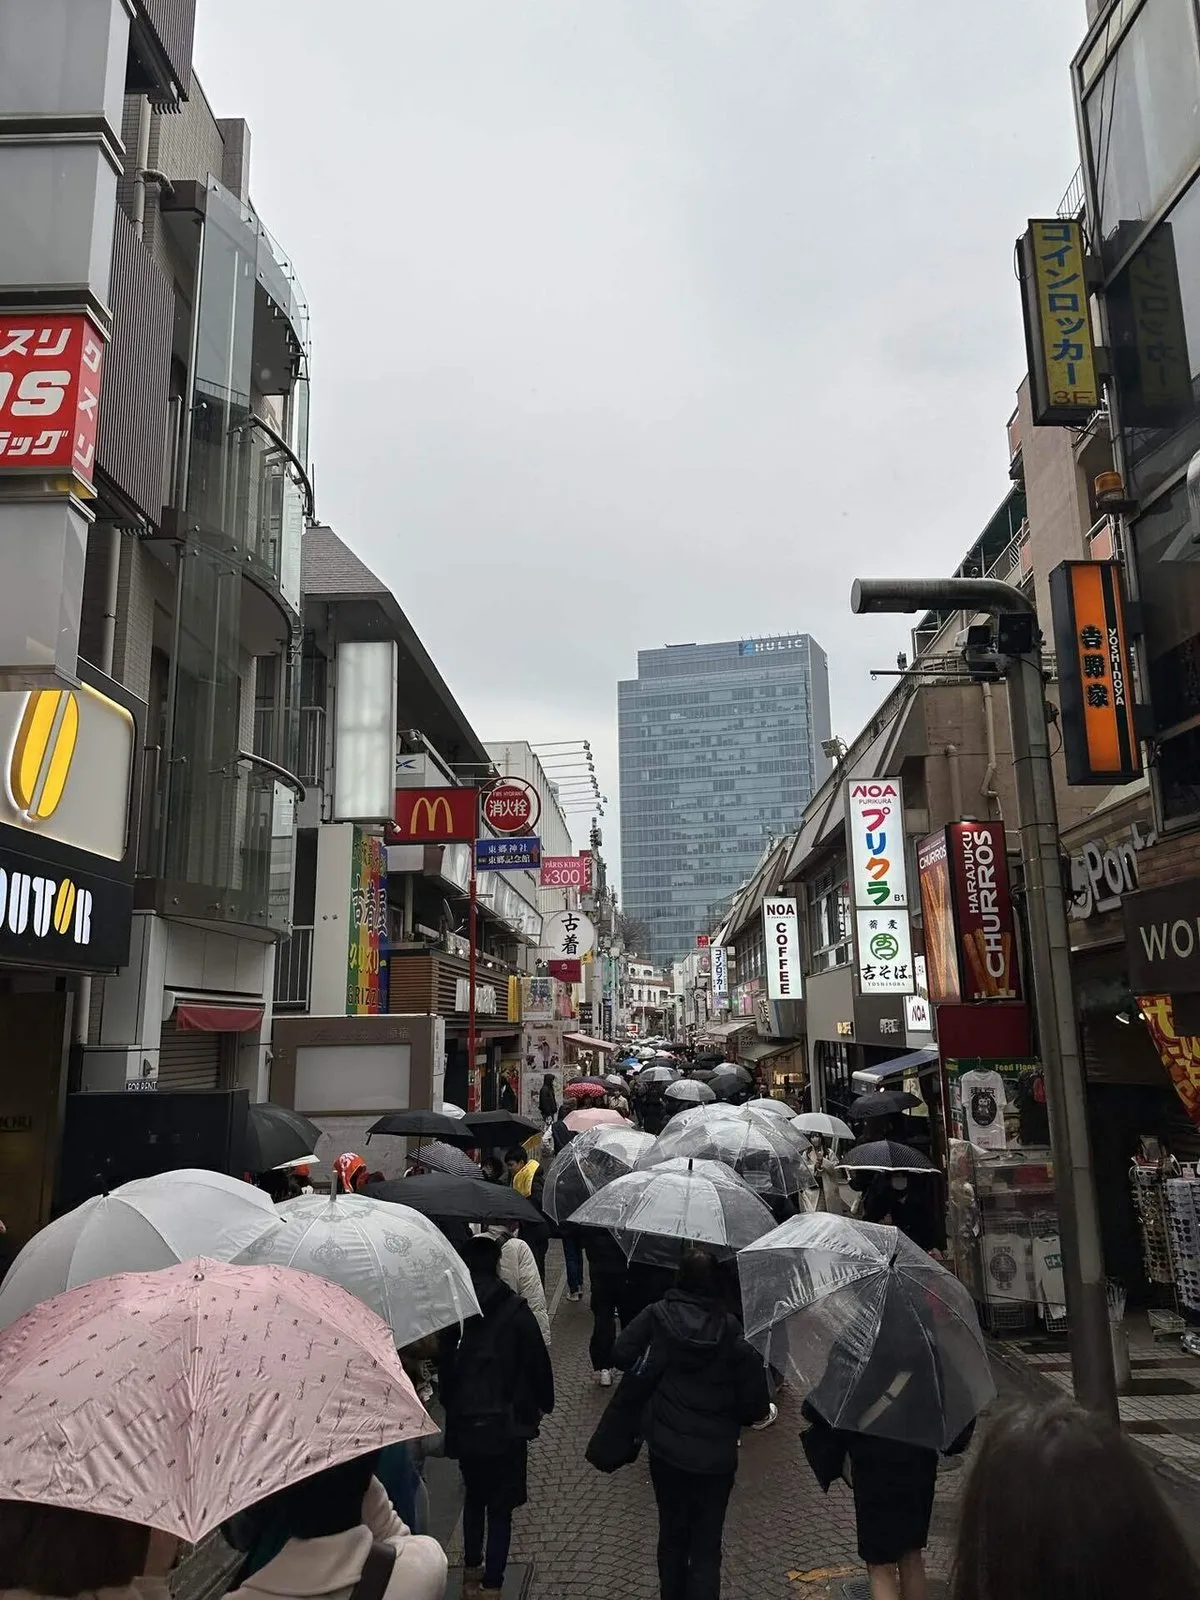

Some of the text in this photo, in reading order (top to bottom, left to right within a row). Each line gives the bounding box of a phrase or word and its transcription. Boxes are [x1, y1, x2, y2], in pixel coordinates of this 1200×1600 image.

[1040, 224, 1086, 386] コインロッカー
[0, 328, 72, 357] スリ
[0, 370, 72, 417] S
[1053, 391, 1093, 405] 3F
[755, 639, 804, 652] HULIC
[1108, 628, 1126, 706] YOSHINOYA
[852, 785, 897, 798] NOA
[490, 799, 528, 817] 消火栓
[488, 843, 528, 854] 東郷神社
[861, 807, 891, 905] プリクラ
[919, 845, 947, 870] CHURROS
[545, 869, 581, 885] ¥300
[961, 831, 980, 913] HARAJUKU
[766, 904, 796, 916] NOA
[894, 893, 905, 902] B1
[973, 830, 1005, 978] CHURROS
[561, 912, 580, 956] 古着
[776, 922, 790, 995] COFFEE
[861, 964, 908, 981] 吉そば
[347, 984, 388, 1009] GRIZZLY
[911, 1005, 927, 1022] NOA
